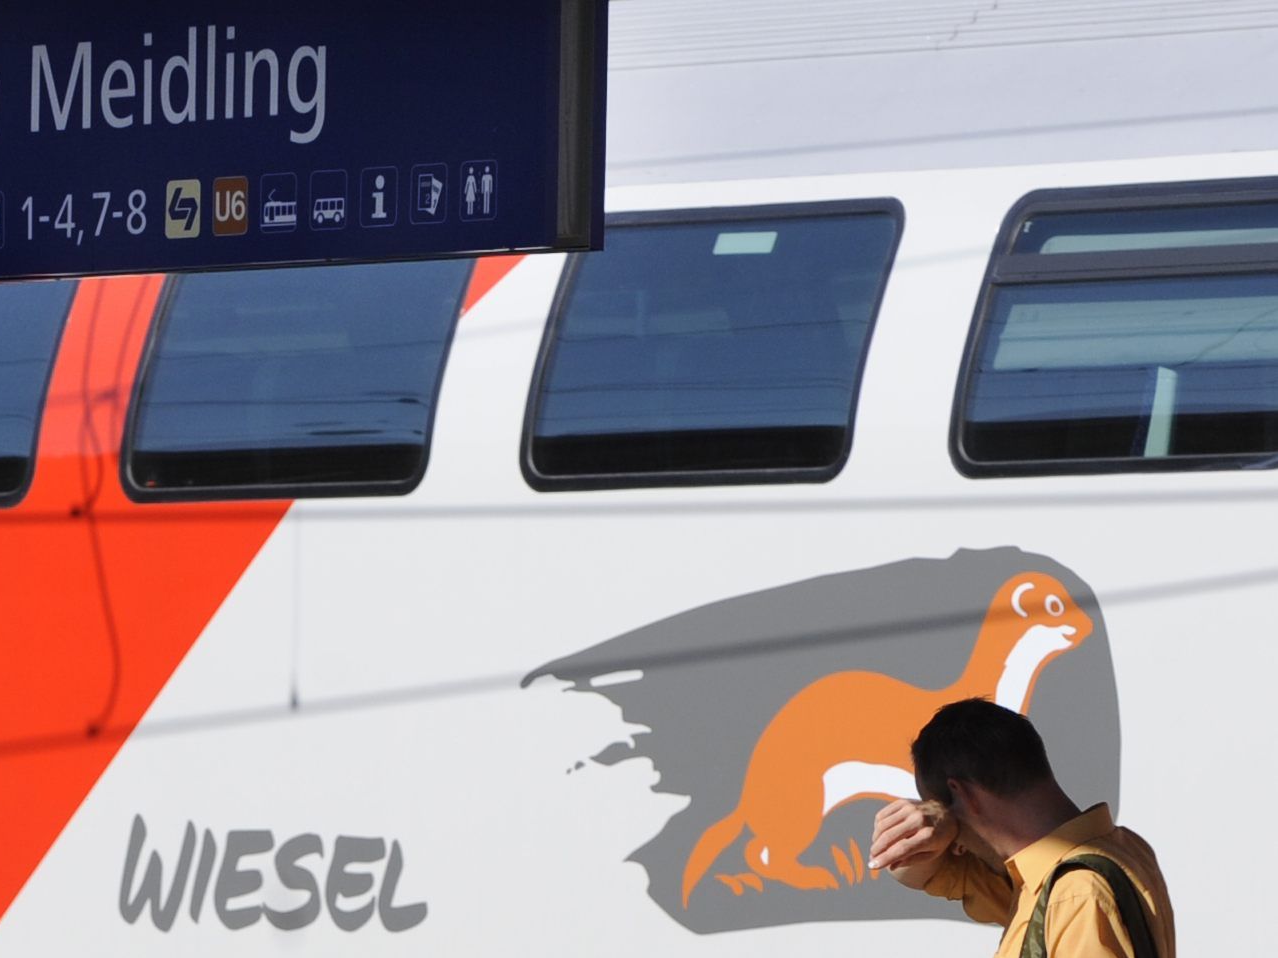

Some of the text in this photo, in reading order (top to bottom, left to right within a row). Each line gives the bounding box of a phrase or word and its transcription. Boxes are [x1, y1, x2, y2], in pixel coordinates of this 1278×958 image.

[30, 25, 327, 144] Meidling
[21, 188, 147, 246] 1-4,7-8
[215, 189, 246, 222] U6
[119, 813, 428, 933] WIESEL
